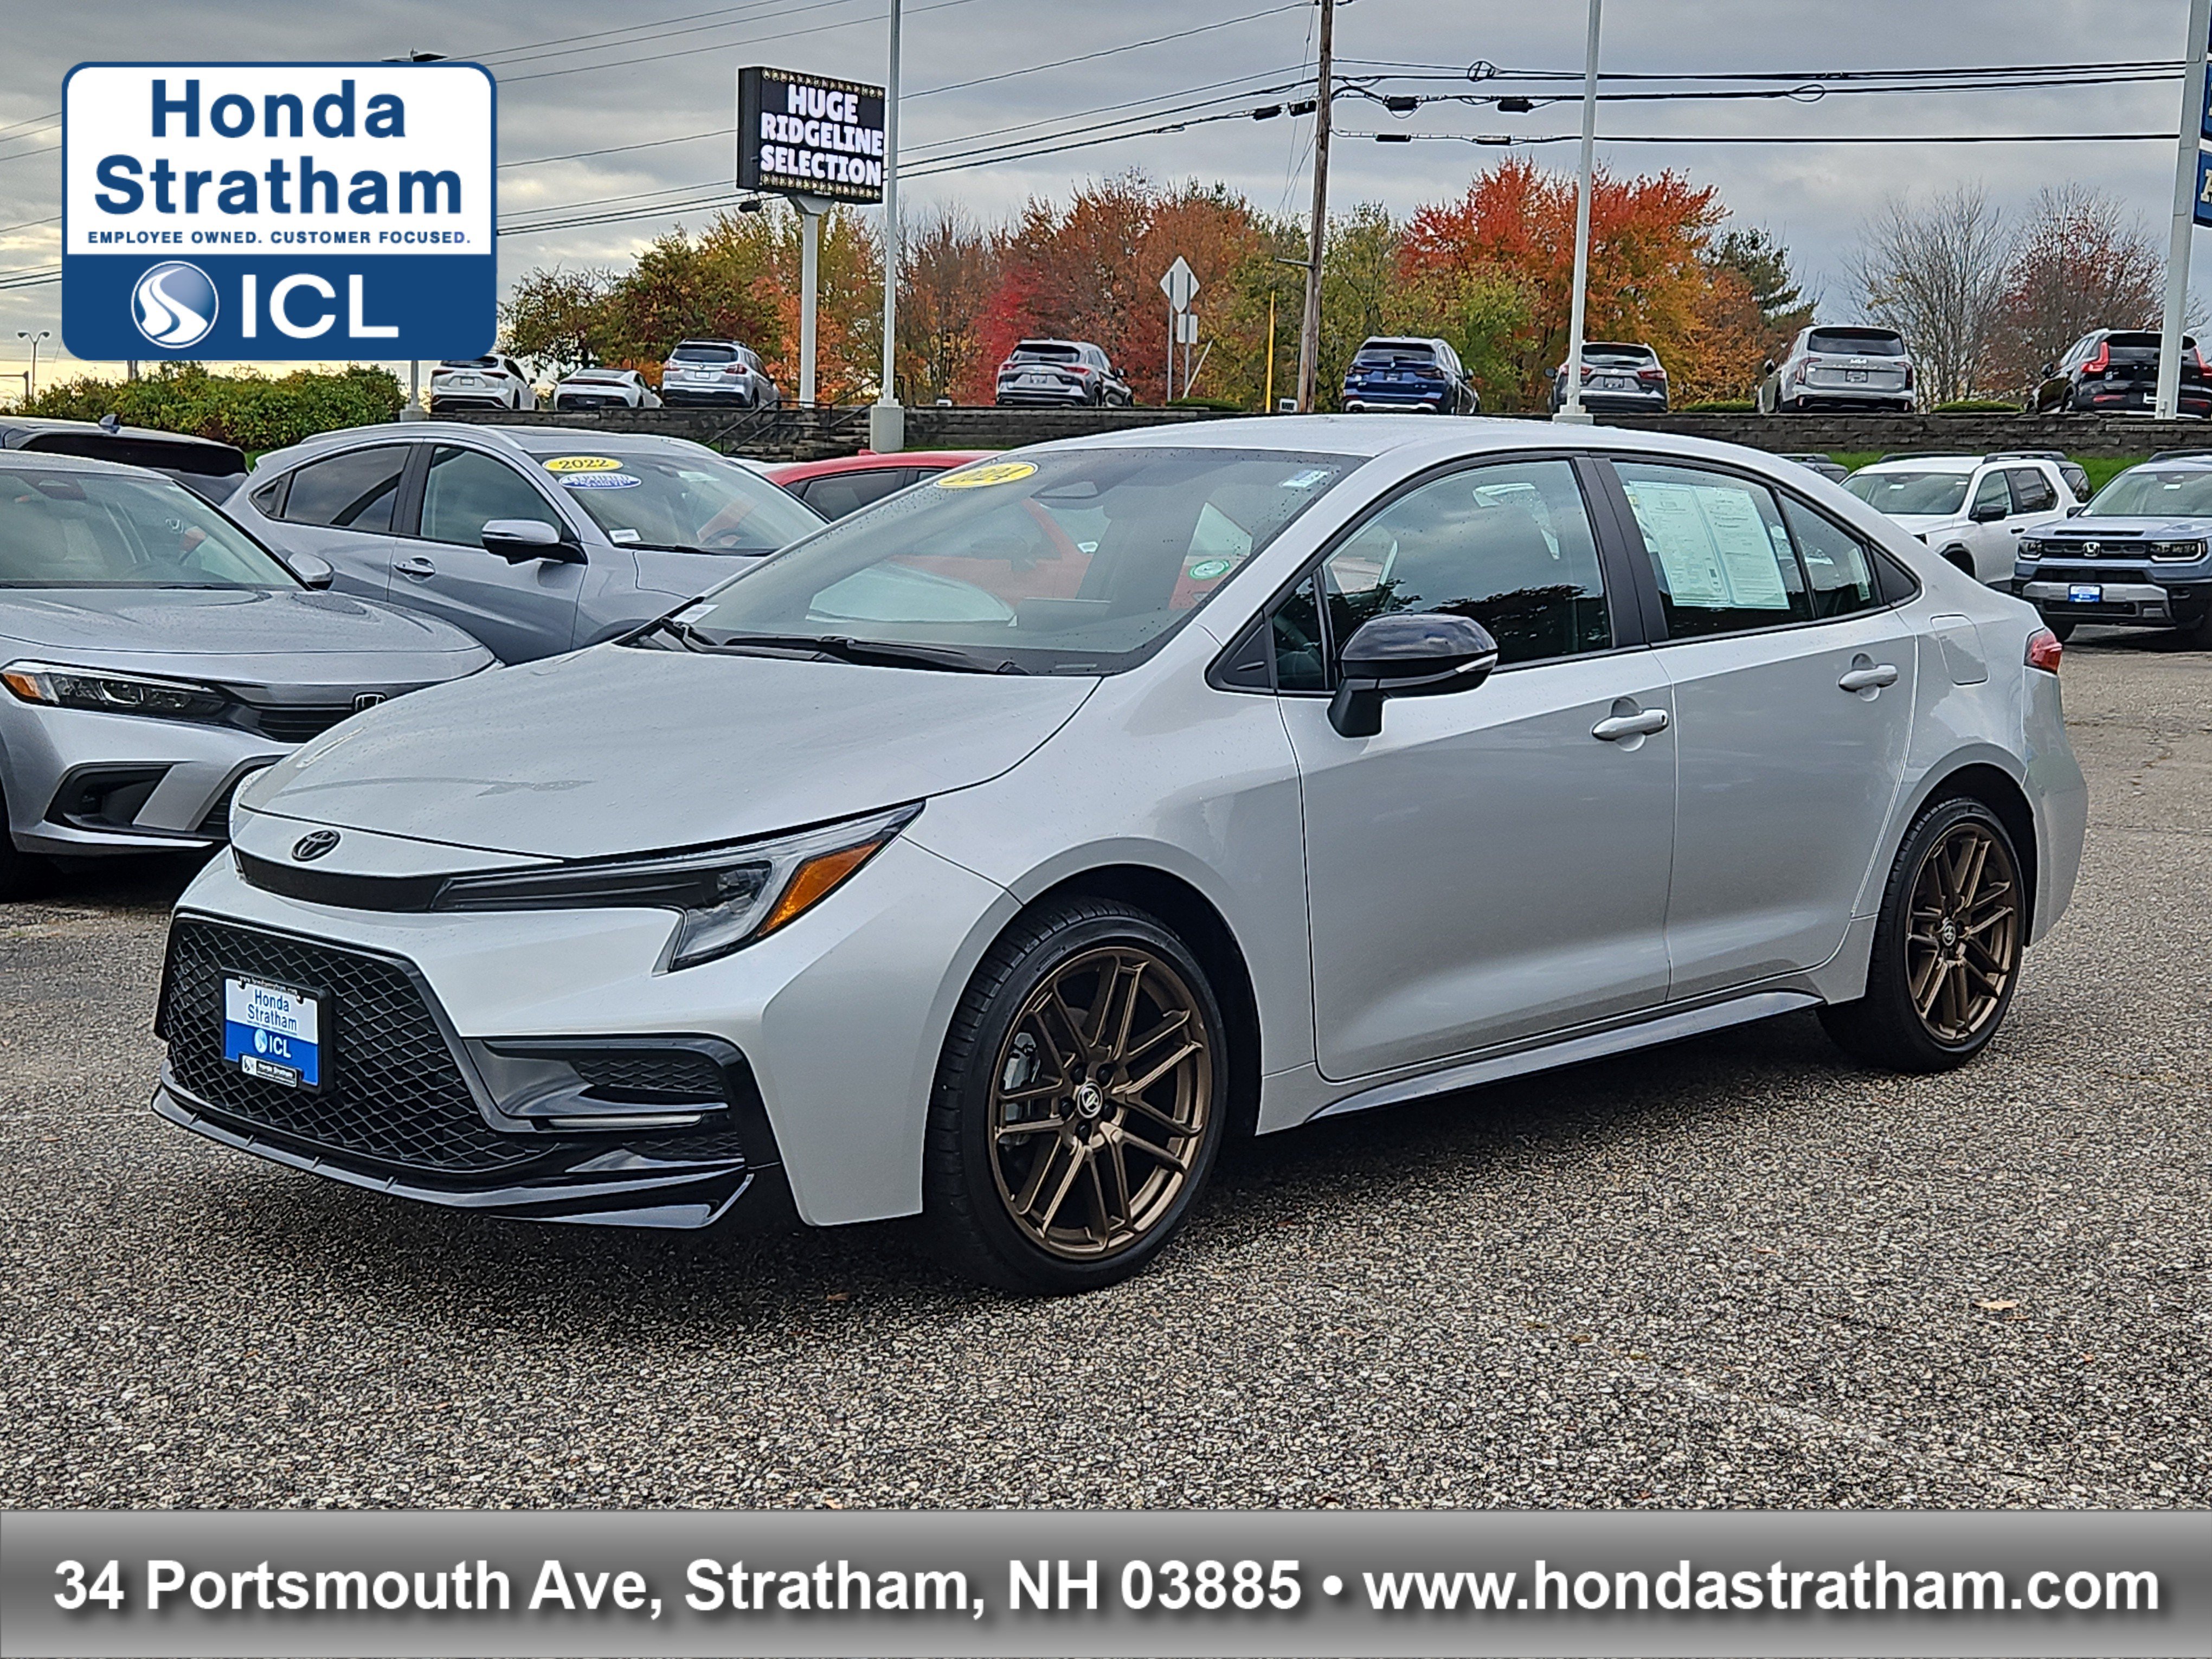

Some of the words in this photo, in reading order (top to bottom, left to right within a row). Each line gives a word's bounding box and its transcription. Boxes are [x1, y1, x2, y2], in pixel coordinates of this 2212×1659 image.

[788, 83, 858, 124] HUGE
[761, 111, 884, 157] RIDGELINE
[760, 144, 882, 187] SELECTION
[558, 459, 609, 470] 2022
[254, 988, 290, 1012] Honda
[247, 1004, 297, 1031] Stratham
[269, 1034, 292, 1058] ICL
